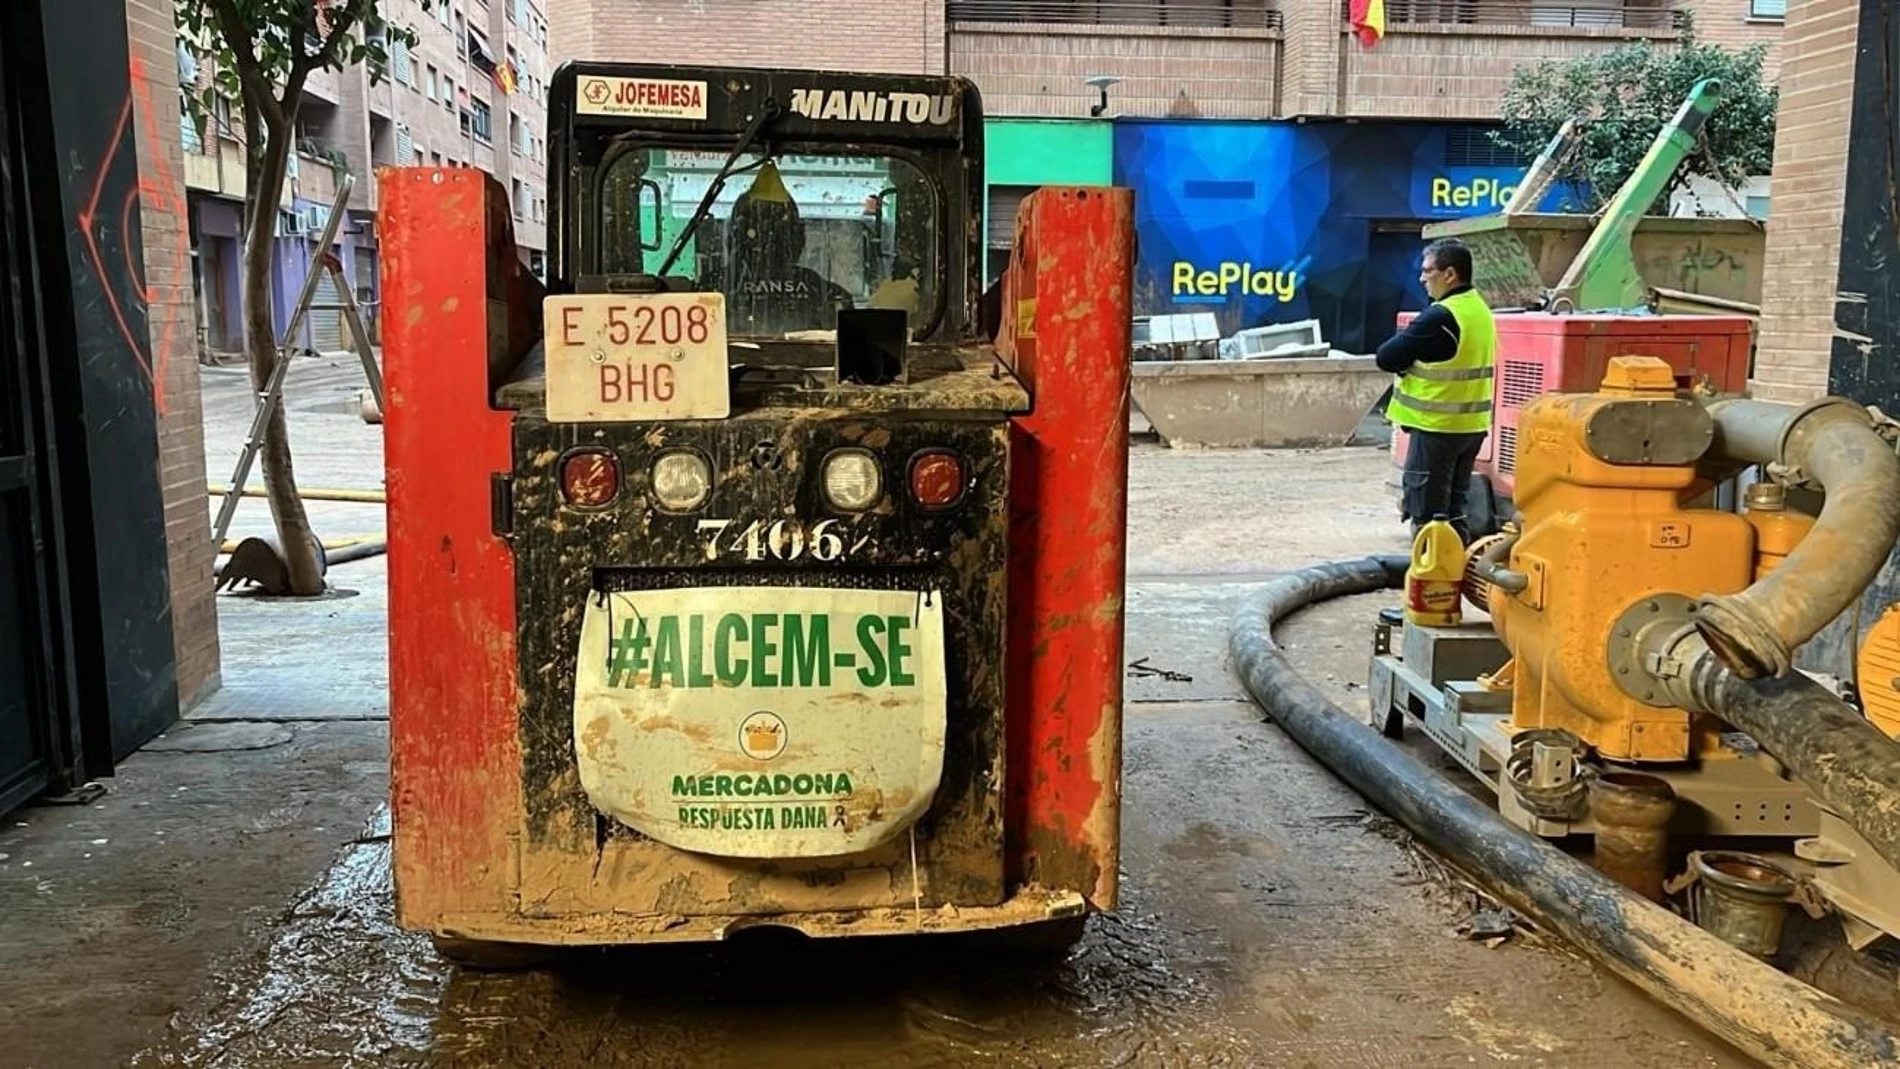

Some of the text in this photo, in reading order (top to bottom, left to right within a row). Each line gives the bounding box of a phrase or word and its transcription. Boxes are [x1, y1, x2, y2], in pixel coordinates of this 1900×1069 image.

[615, 82, 701, 108] JOFEMESA
[1432, 178, 1518, 207] RePla
[1172, 261, 1297, 302] RePlay
[562, 305, 708, 346] E 5208
[600, 363, 675, 403] BHG
[606, 613, 915, 689] #ALCEM-SE
[672, 773, 853, 796] MERCADONA
[678, 806, 827, 830] RESPUESTA DANA
